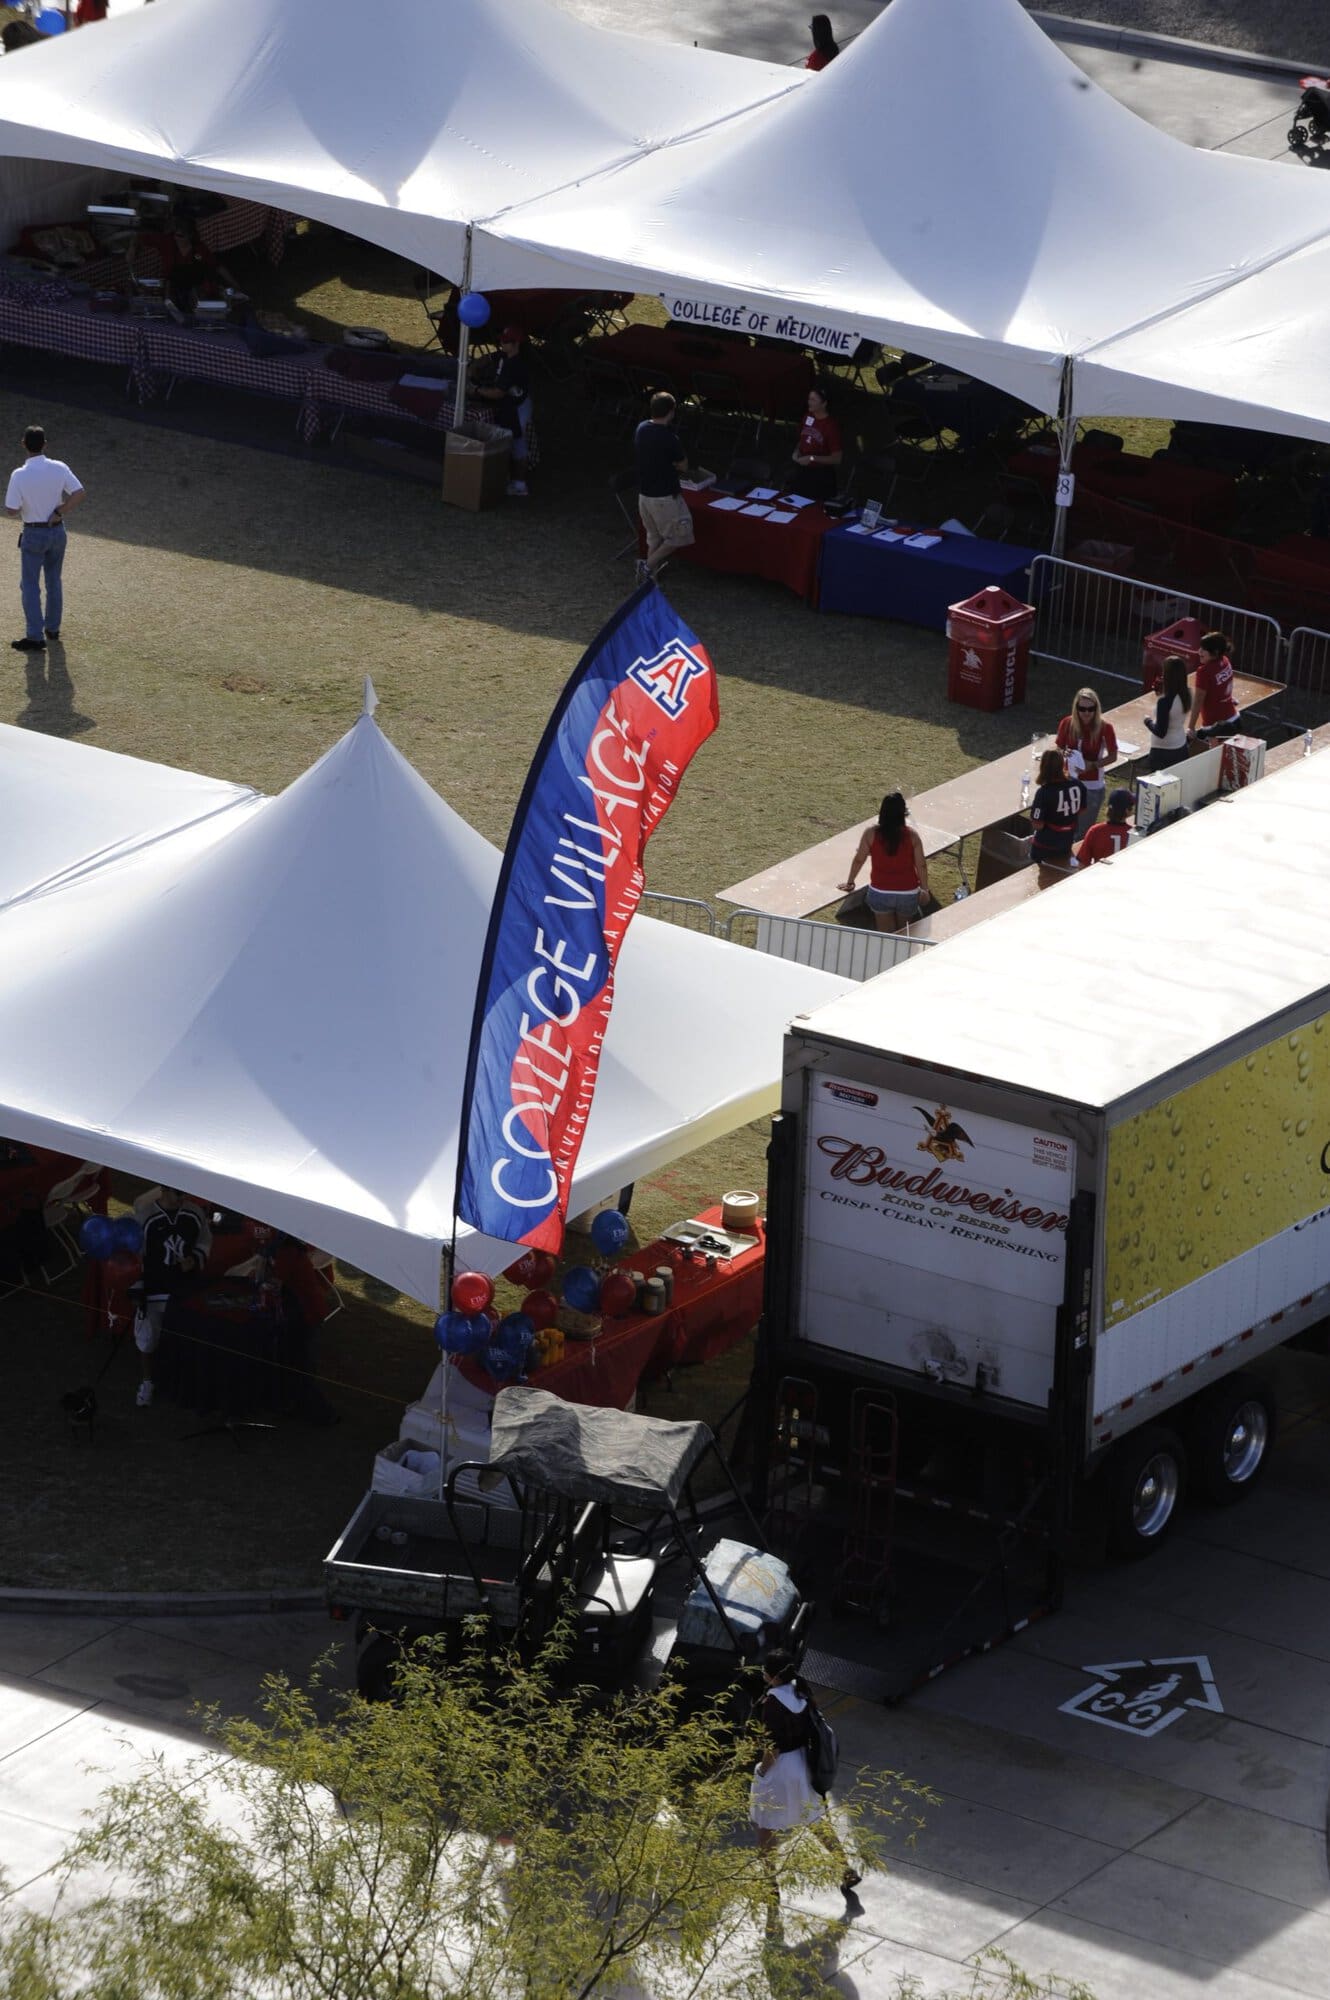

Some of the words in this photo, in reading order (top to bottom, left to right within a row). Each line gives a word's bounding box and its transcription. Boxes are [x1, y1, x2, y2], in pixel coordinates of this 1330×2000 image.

[673, 300, 744, 327] COLLEGE
[748, 313, 770, 332] OF
[776, 318, 852, 350] MEDICINE
[625, 638, 709, 721] A
[491, 927, 597, 1209] COLLEGE
[544, 699, 651, 909] VILLAGE
[1033, 1137, 1068, 1151] CAUTION
[817, 1135, 1070, 1232] Budweiser
[881, 1193, 925, 1211] KING
[930, 1206, 953, 1218] OF
[956, 1213, 1011, 1236] BEERS
[820, 1190, 871, 1211] CRISP
[883, 1207, 939, 1230] CLEAN
[950, 1225, 1060, 1264] REFRESHING
